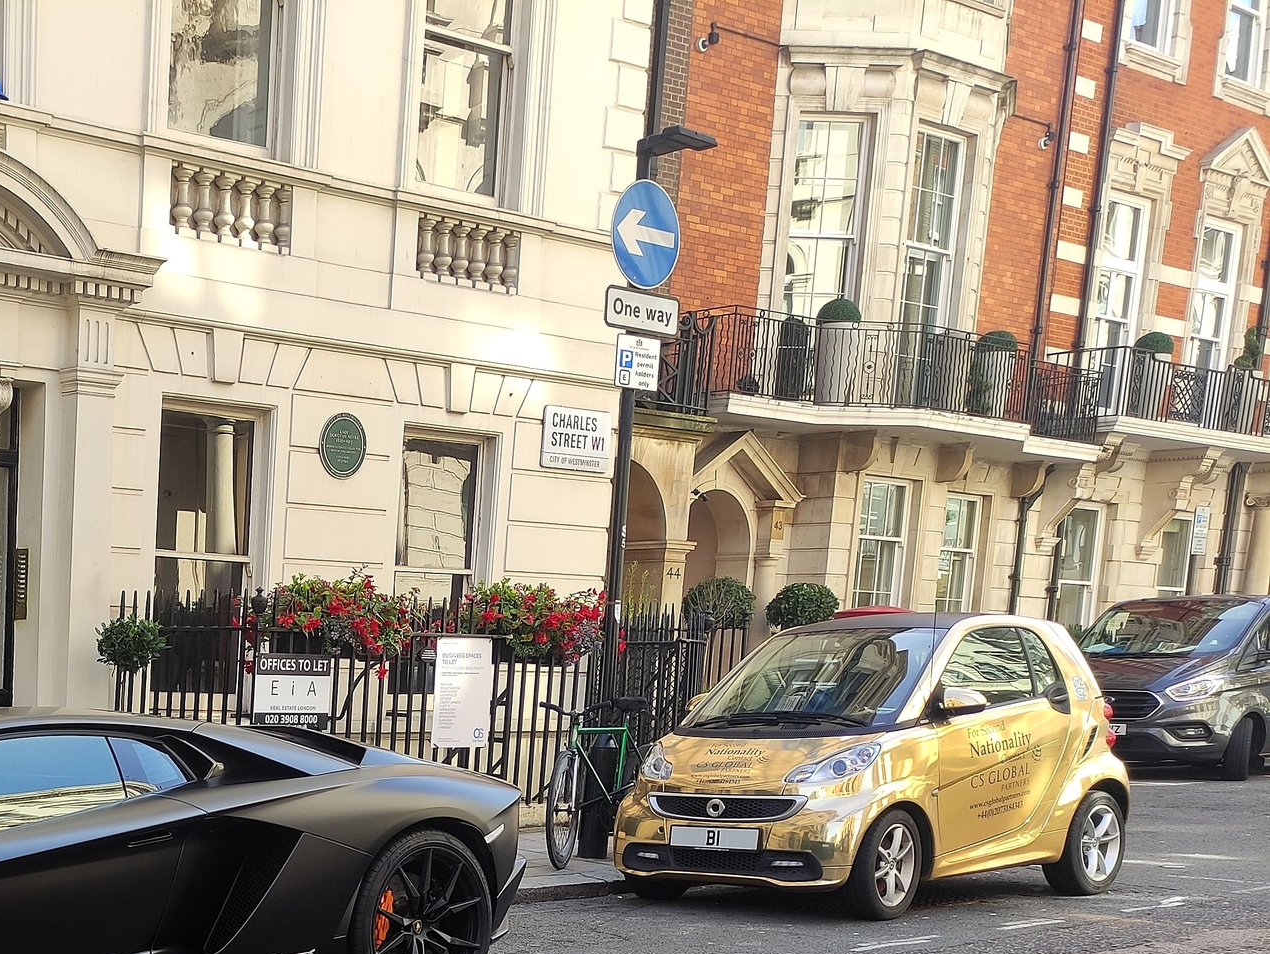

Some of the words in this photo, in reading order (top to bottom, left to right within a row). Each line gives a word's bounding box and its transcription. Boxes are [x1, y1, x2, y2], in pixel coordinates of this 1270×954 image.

[613, 297, 641, 319] One
[646, 307, 672, 327] way
[635, 352, 657, 360] Resident
[635, 370, 654, 379] holders
[552, 412, 598, 432] CHARLES
[551, 431, 588, 450] STREET
[591, 436, 605, 452] W1
[550, 455, 561, 463] CITY
[568, 458, 600, 468] WESTMINSTER
[774, 520, 783, 531] 43
[666, 567, 681, 579] 44
[260, 658, 296, 671] OFFICES
[298, 659, 311, 671] TO
[313, 660, 329, 672] LET
[265, 714, 279, 724] 020
[280, 714, 299, 724] 3908
[300, 714, 318, 724] 8000
[967, 727, 979, 739] For
[980, 720, 1006, 736] Second
[969, 731, 1031, 759] Nationality
[705, 747, 766, 758] Nationality
[970, 773, 985, 789] CS
[988, 762, 1031, 785] GLOBAL
[1000, 778, 1030, 792] PARTNERS
